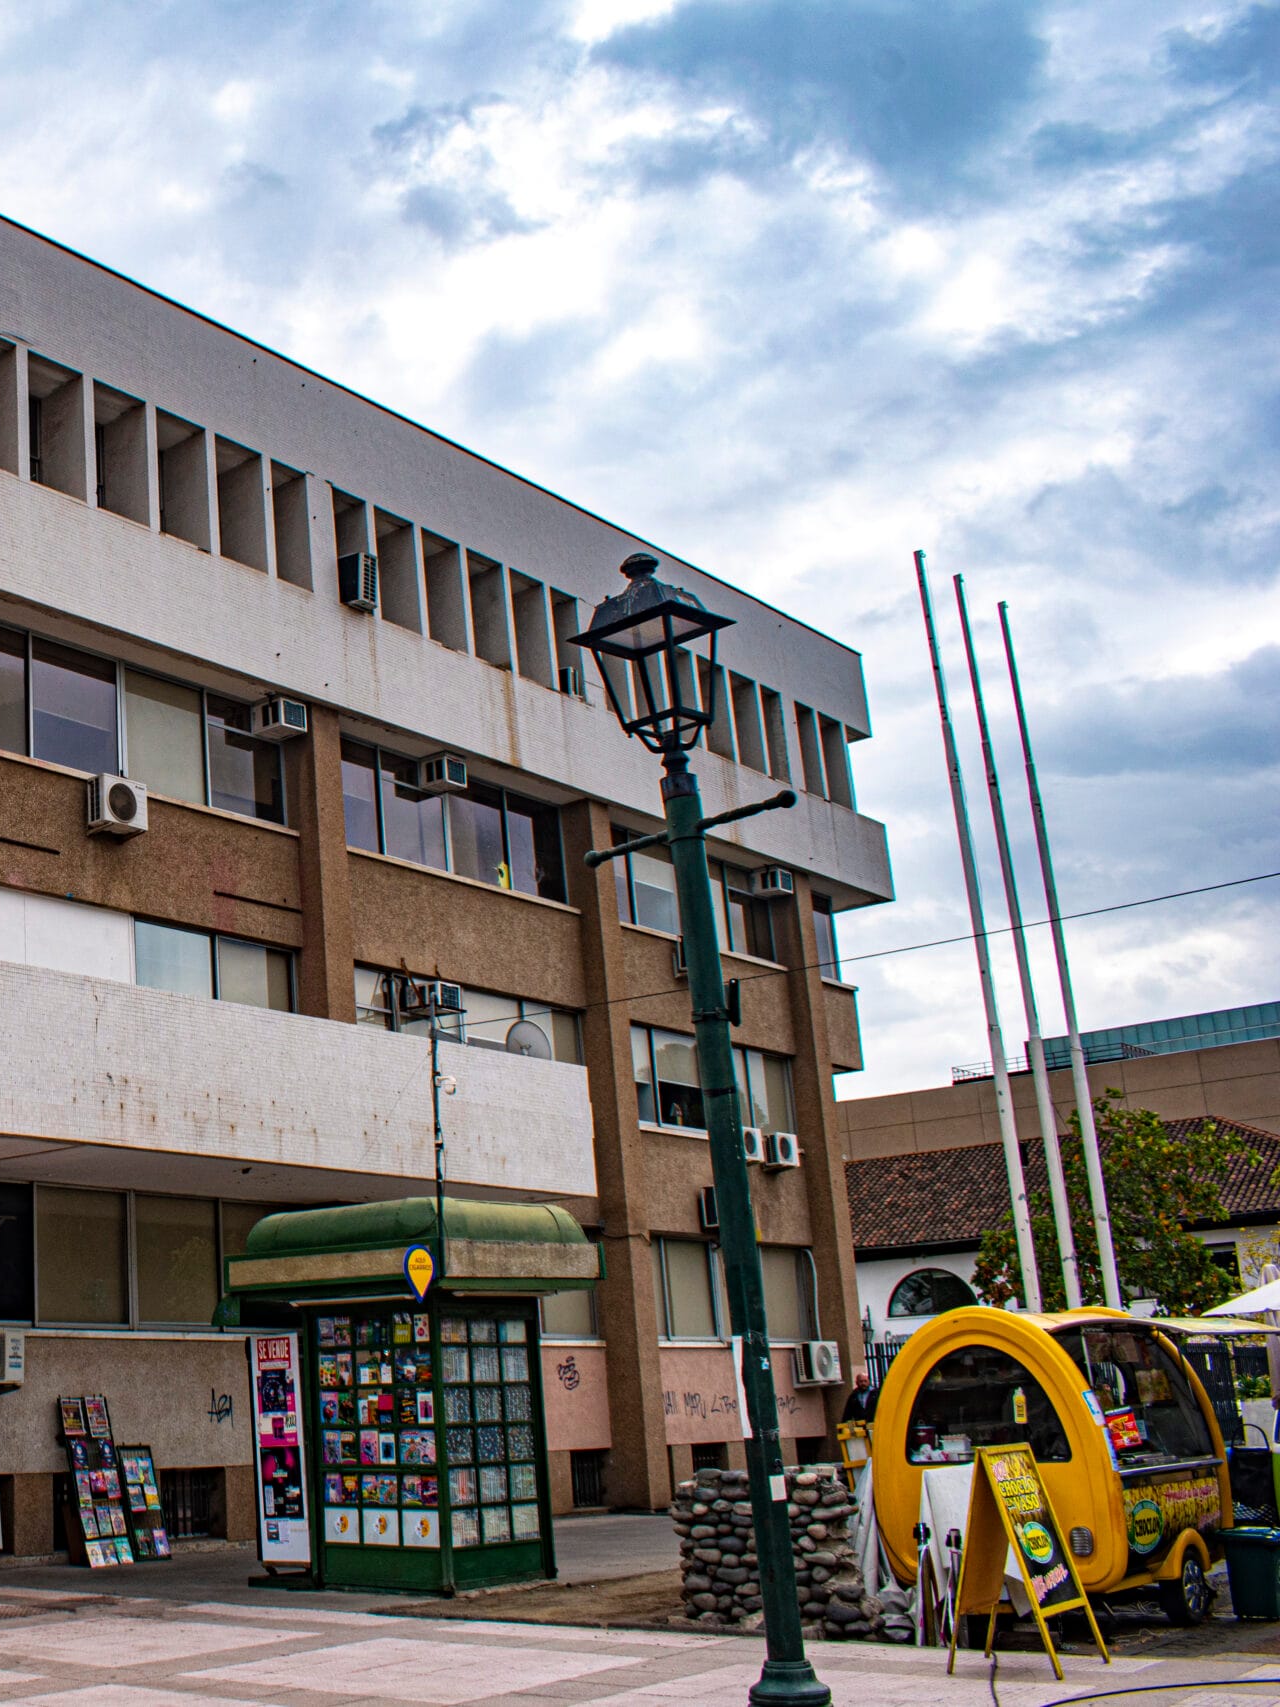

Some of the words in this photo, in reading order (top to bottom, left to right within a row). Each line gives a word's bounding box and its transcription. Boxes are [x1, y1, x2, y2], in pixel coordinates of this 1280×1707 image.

[258, 1340, 267, 1360] SE
[268, 1339, 289, 1359] VENDE
[998, 1478, 1036, 1497] CHOCLO
[1015, 1494, 1040, 1511] VASO
